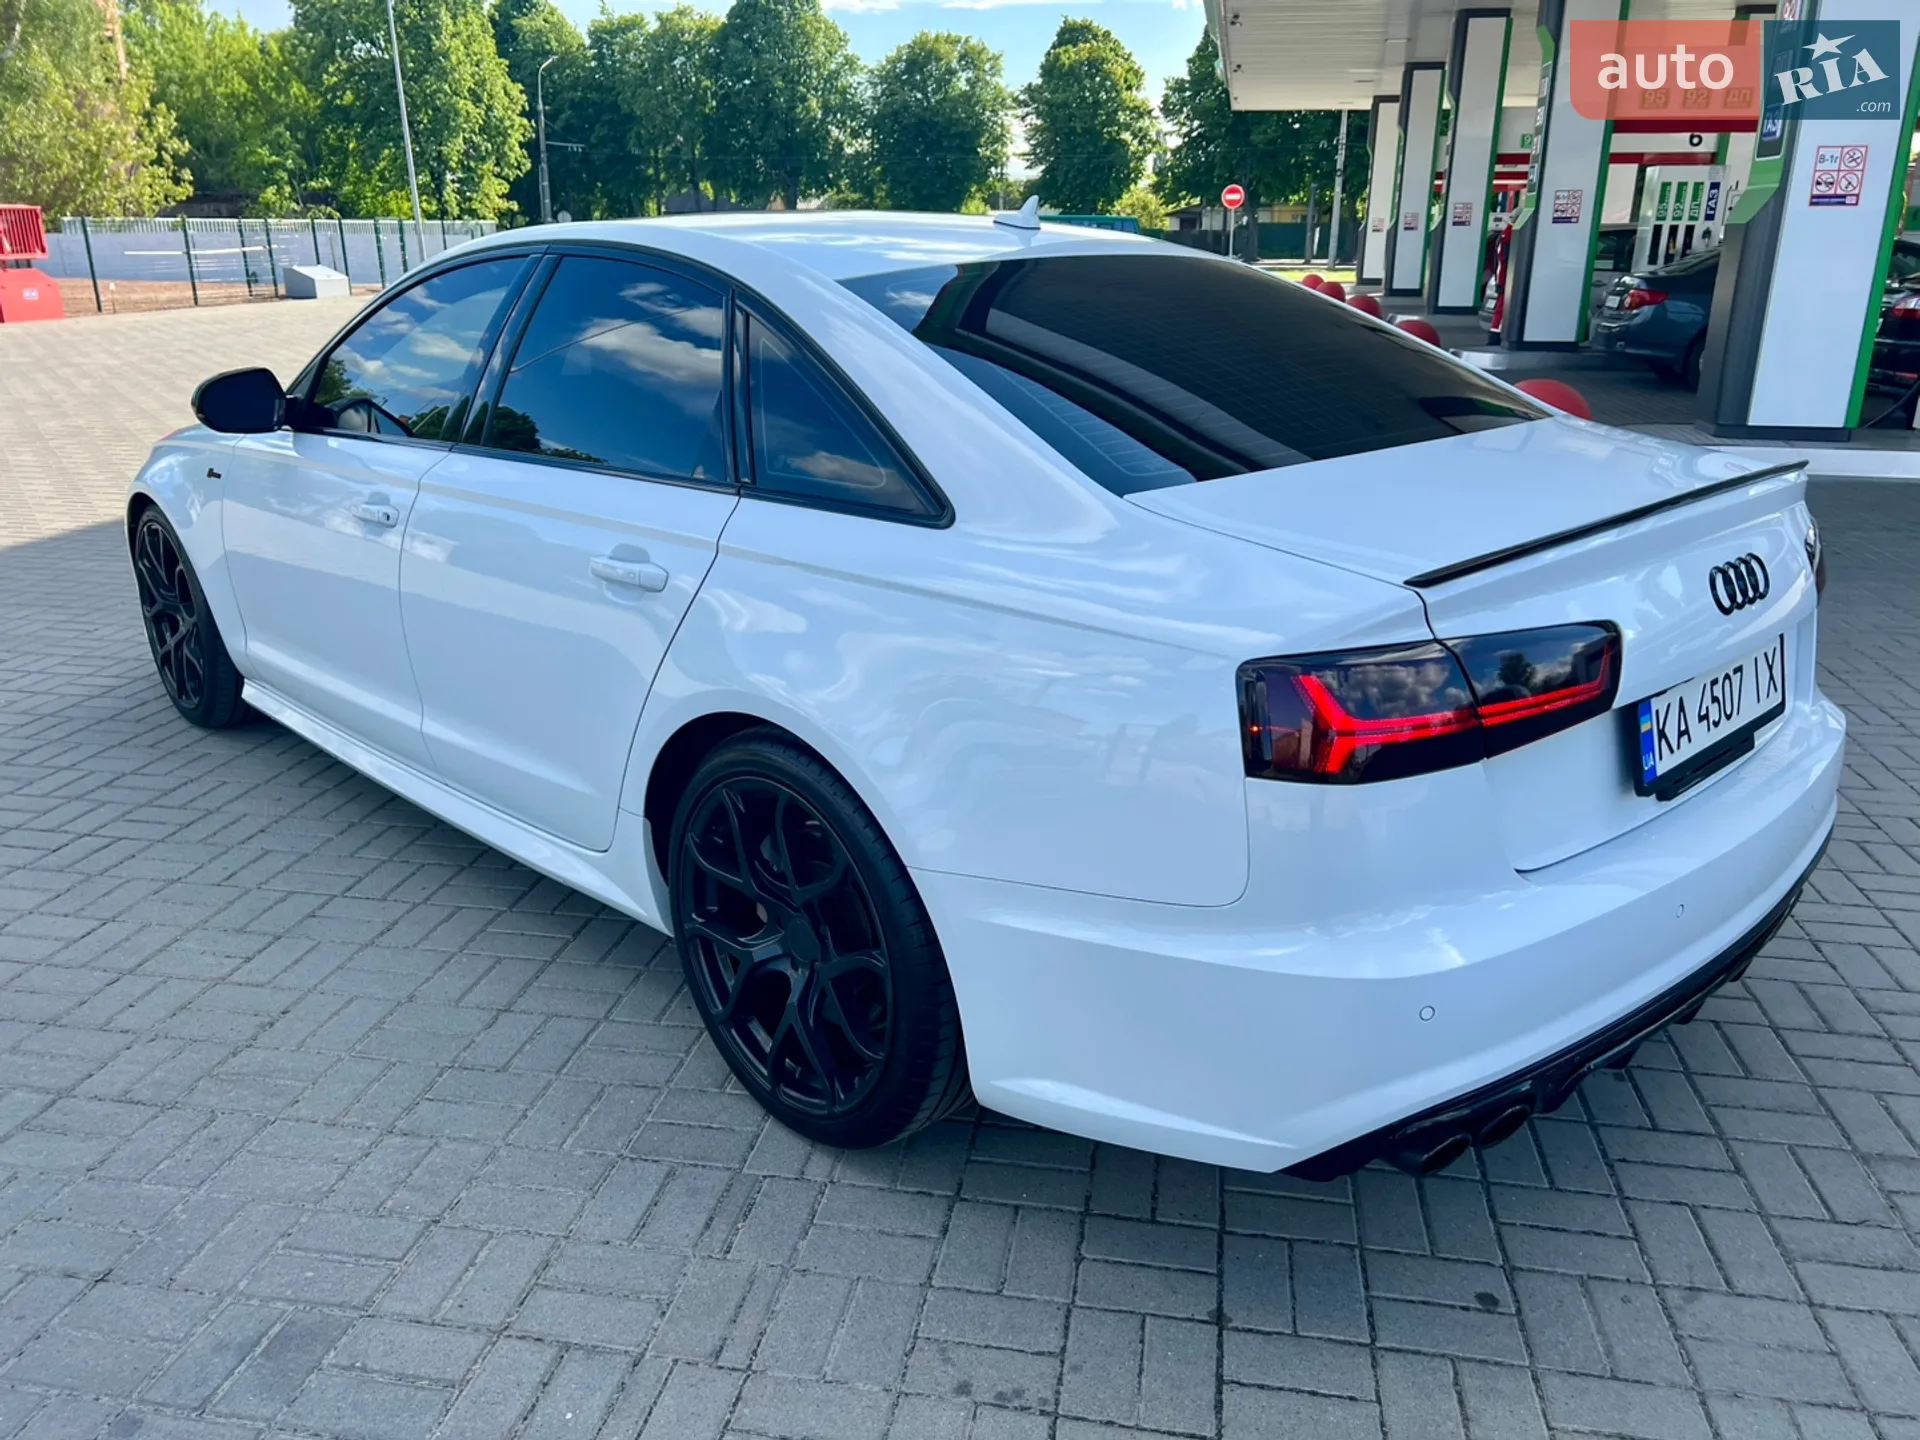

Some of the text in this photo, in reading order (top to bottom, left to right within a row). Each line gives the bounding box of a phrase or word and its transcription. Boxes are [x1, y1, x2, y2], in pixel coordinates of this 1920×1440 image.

[1643, 90, 1666, 104] 95
[1706, 189, 1719, 215] ГАЗ
[1655, 695, 1692, 761] KA
[1697, 664, 1744, 733] 4507
[1642, 752, 1655, 770] UA
